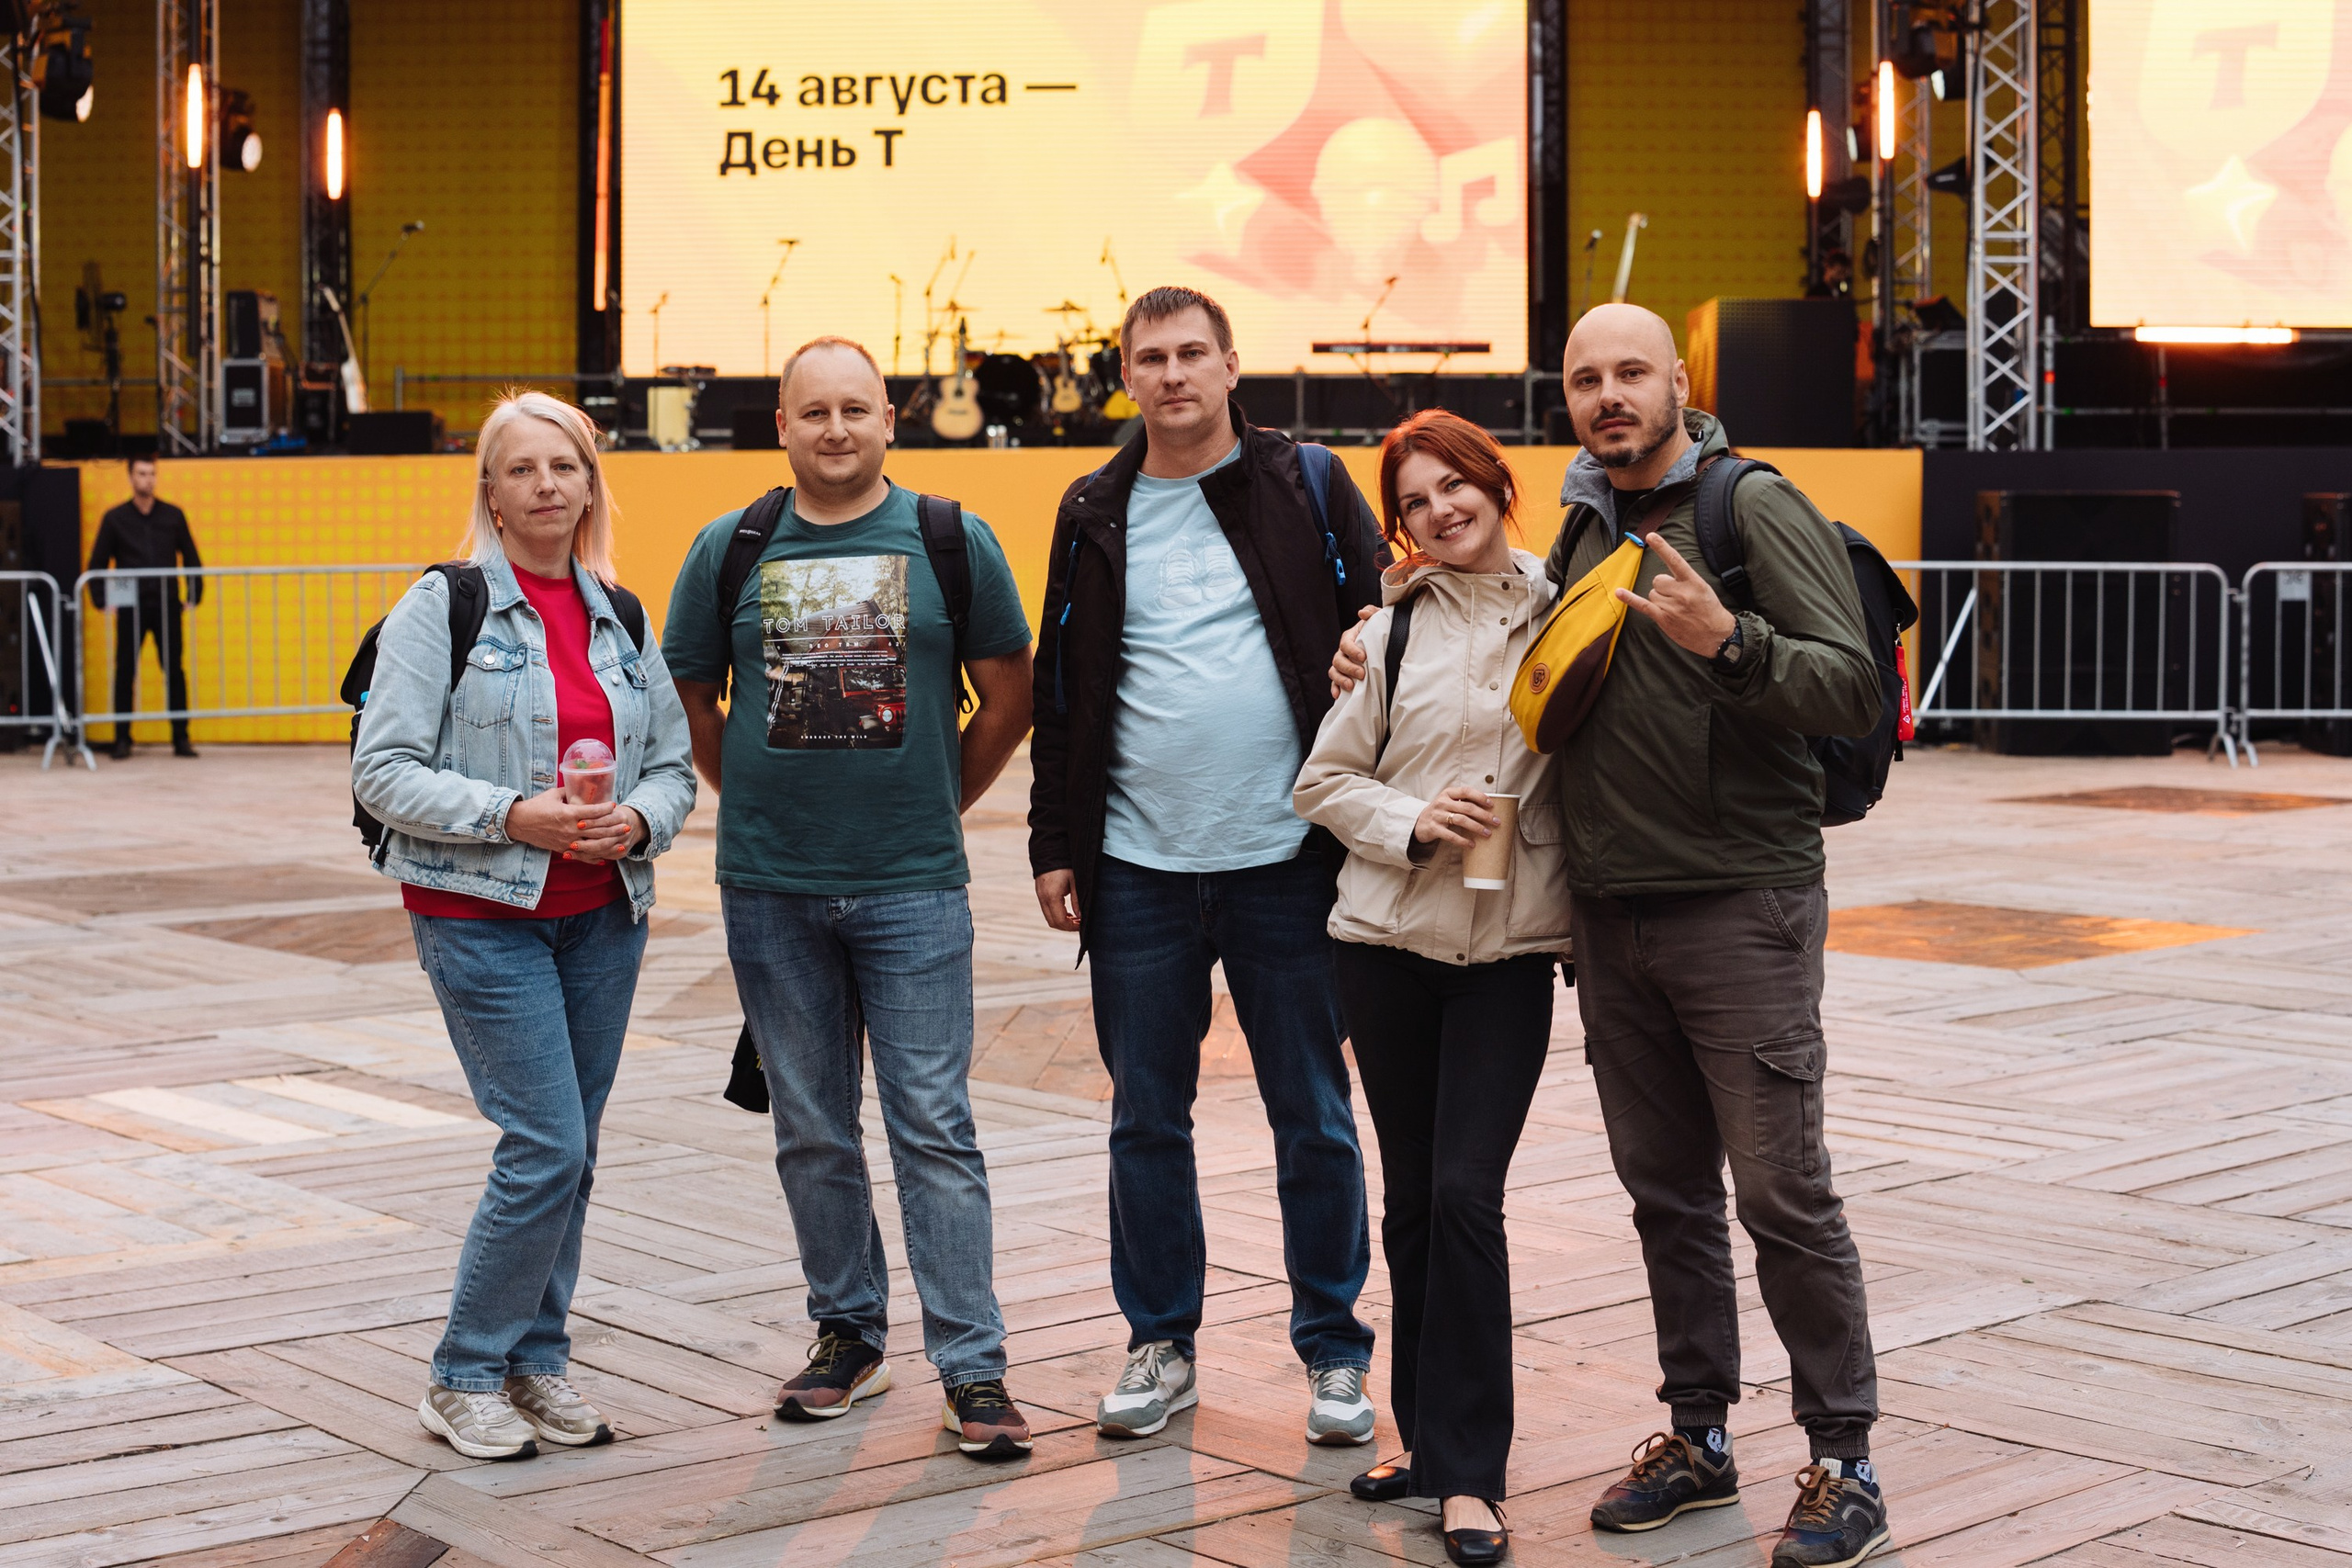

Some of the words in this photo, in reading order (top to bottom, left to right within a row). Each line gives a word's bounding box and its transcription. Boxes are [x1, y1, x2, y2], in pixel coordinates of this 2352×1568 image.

[719, 69, 781, 107] 14
[798, 73, 1009, 116] августа
[719, 130, 857, 176] День
[874, 129, 904, 167] Т
[763, 617, 808, 635] TOM
[822, 614, 906, 631] TAILOR
